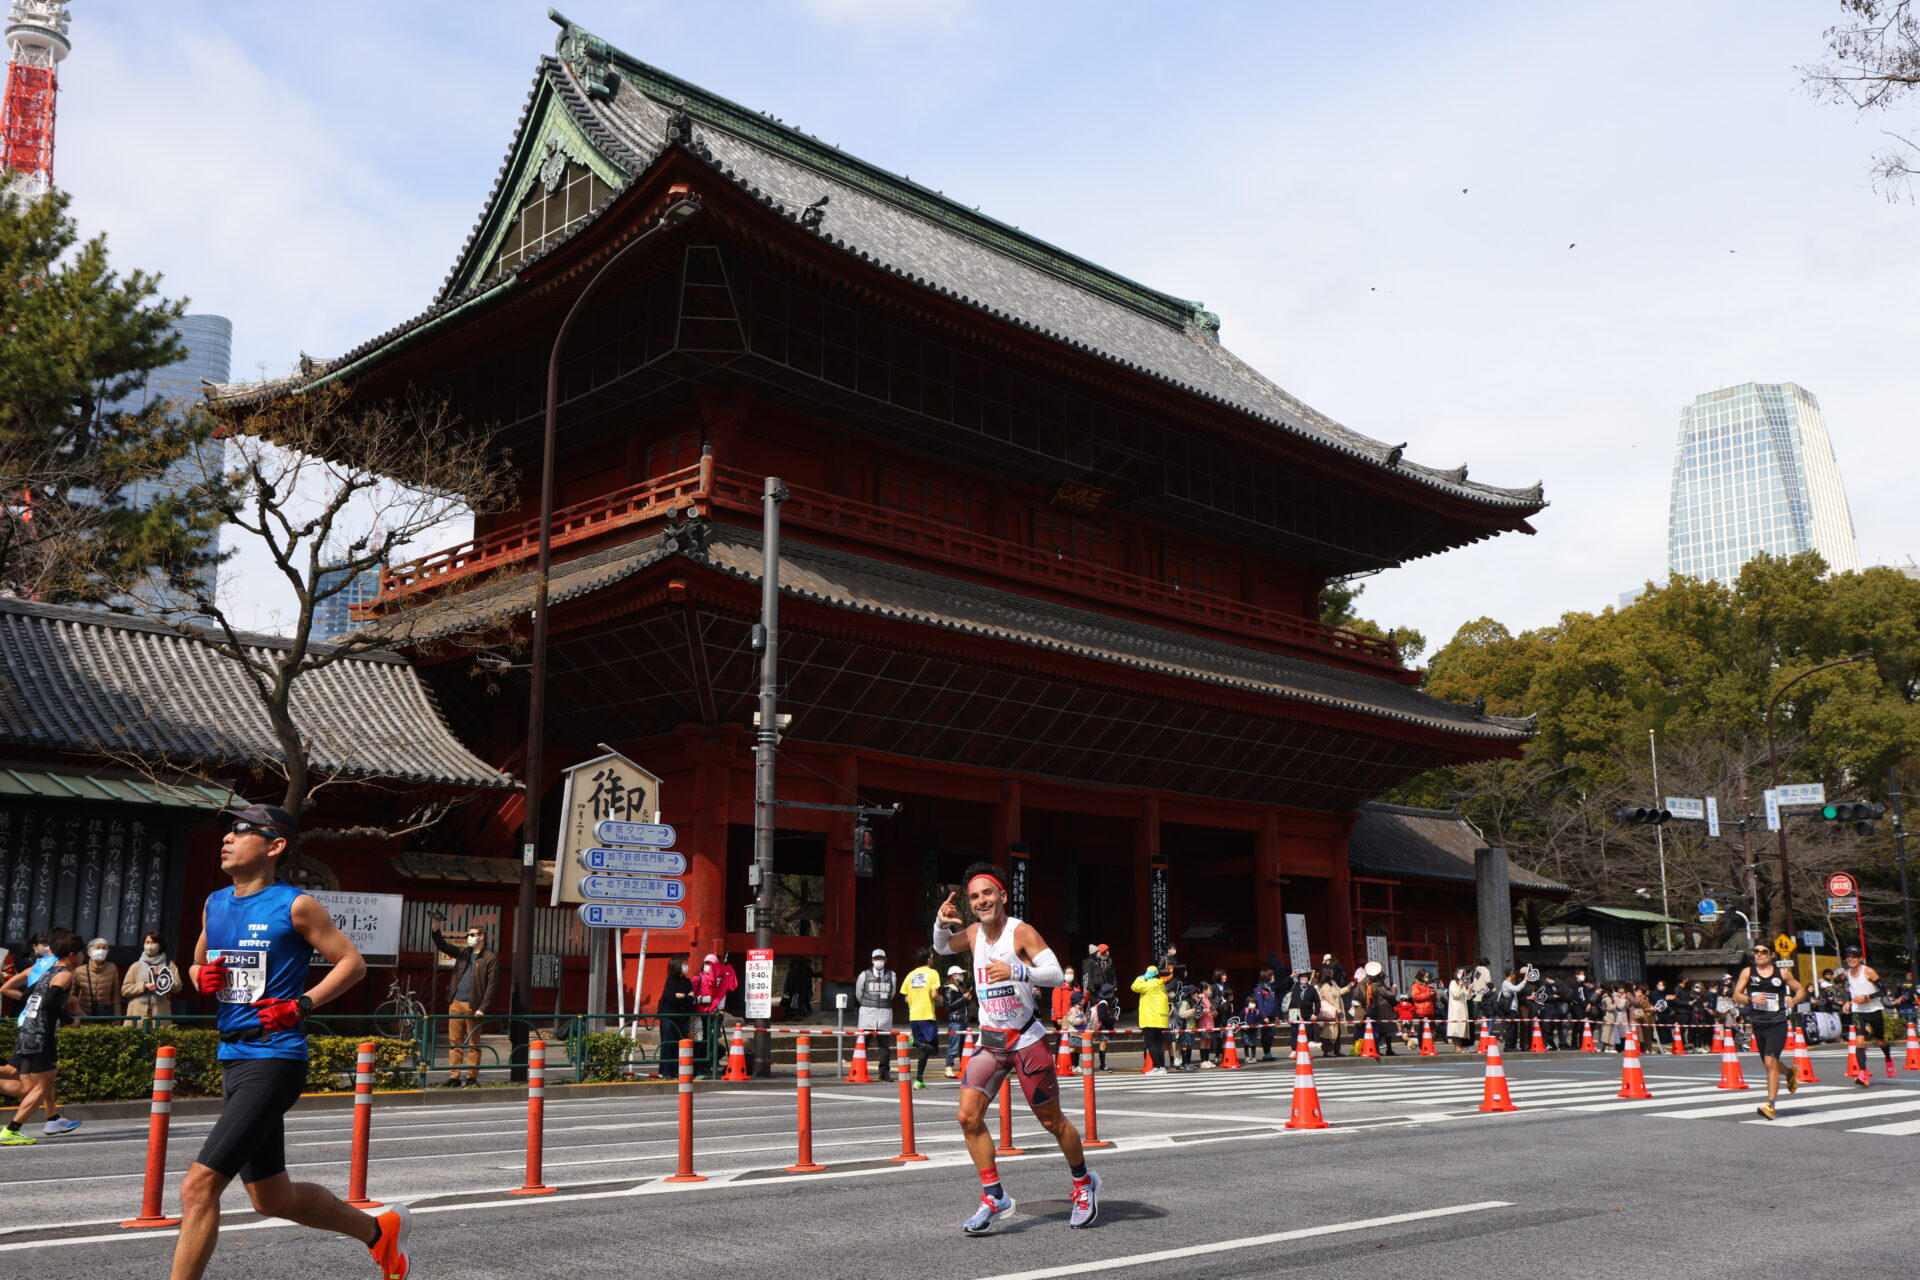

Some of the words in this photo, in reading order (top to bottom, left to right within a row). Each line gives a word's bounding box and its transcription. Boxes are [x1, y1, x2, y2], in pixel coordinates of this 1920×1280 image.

[587, 768, 646, 821] 御
[604, 825, 655, 834] 東京タワー
[615, 834, 629, 842] Tokyo
[608, 852, 665, 863] 地下鉄御成門駅
[145, 841, 166, 923] 今月のことは
[606, 880, 664, 890] 地下鉄芝公園駅
[311, 895, 378, 905] からはじまる幸せ
[606, 907, 664, 917] 地下鉄大門駅
[333, 914, 378, 931] 浄土宗
